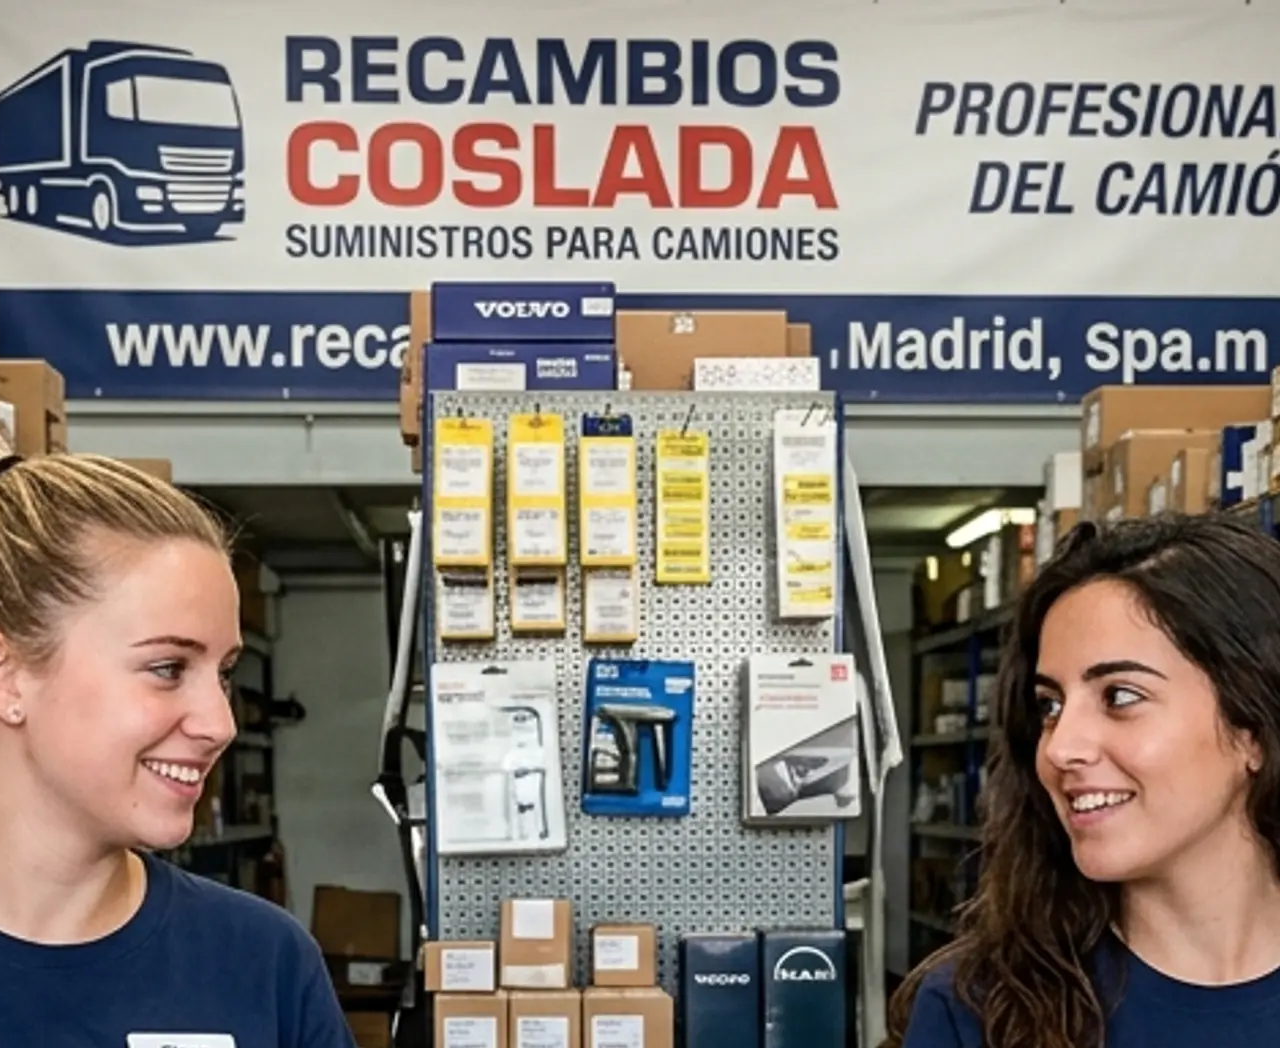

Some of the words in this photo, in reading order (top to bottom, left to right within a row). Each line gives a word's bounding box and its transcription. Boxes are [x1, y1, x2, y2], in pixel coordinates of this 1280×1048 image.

[286, 36, 839, 107] RECAMBIOS
[288, 122, 836, 208] COSLADA
[970, 162, 1074, 214] DEL
[286, 224, 532, 259] SUMINISTROS
[547, 227, 639, 259] PARA
[653, 227, 838, 260] CAMIONES
[850, 316, 1060, 379] Madrid,
[1086, 323, 1268, 384] Spa.m
